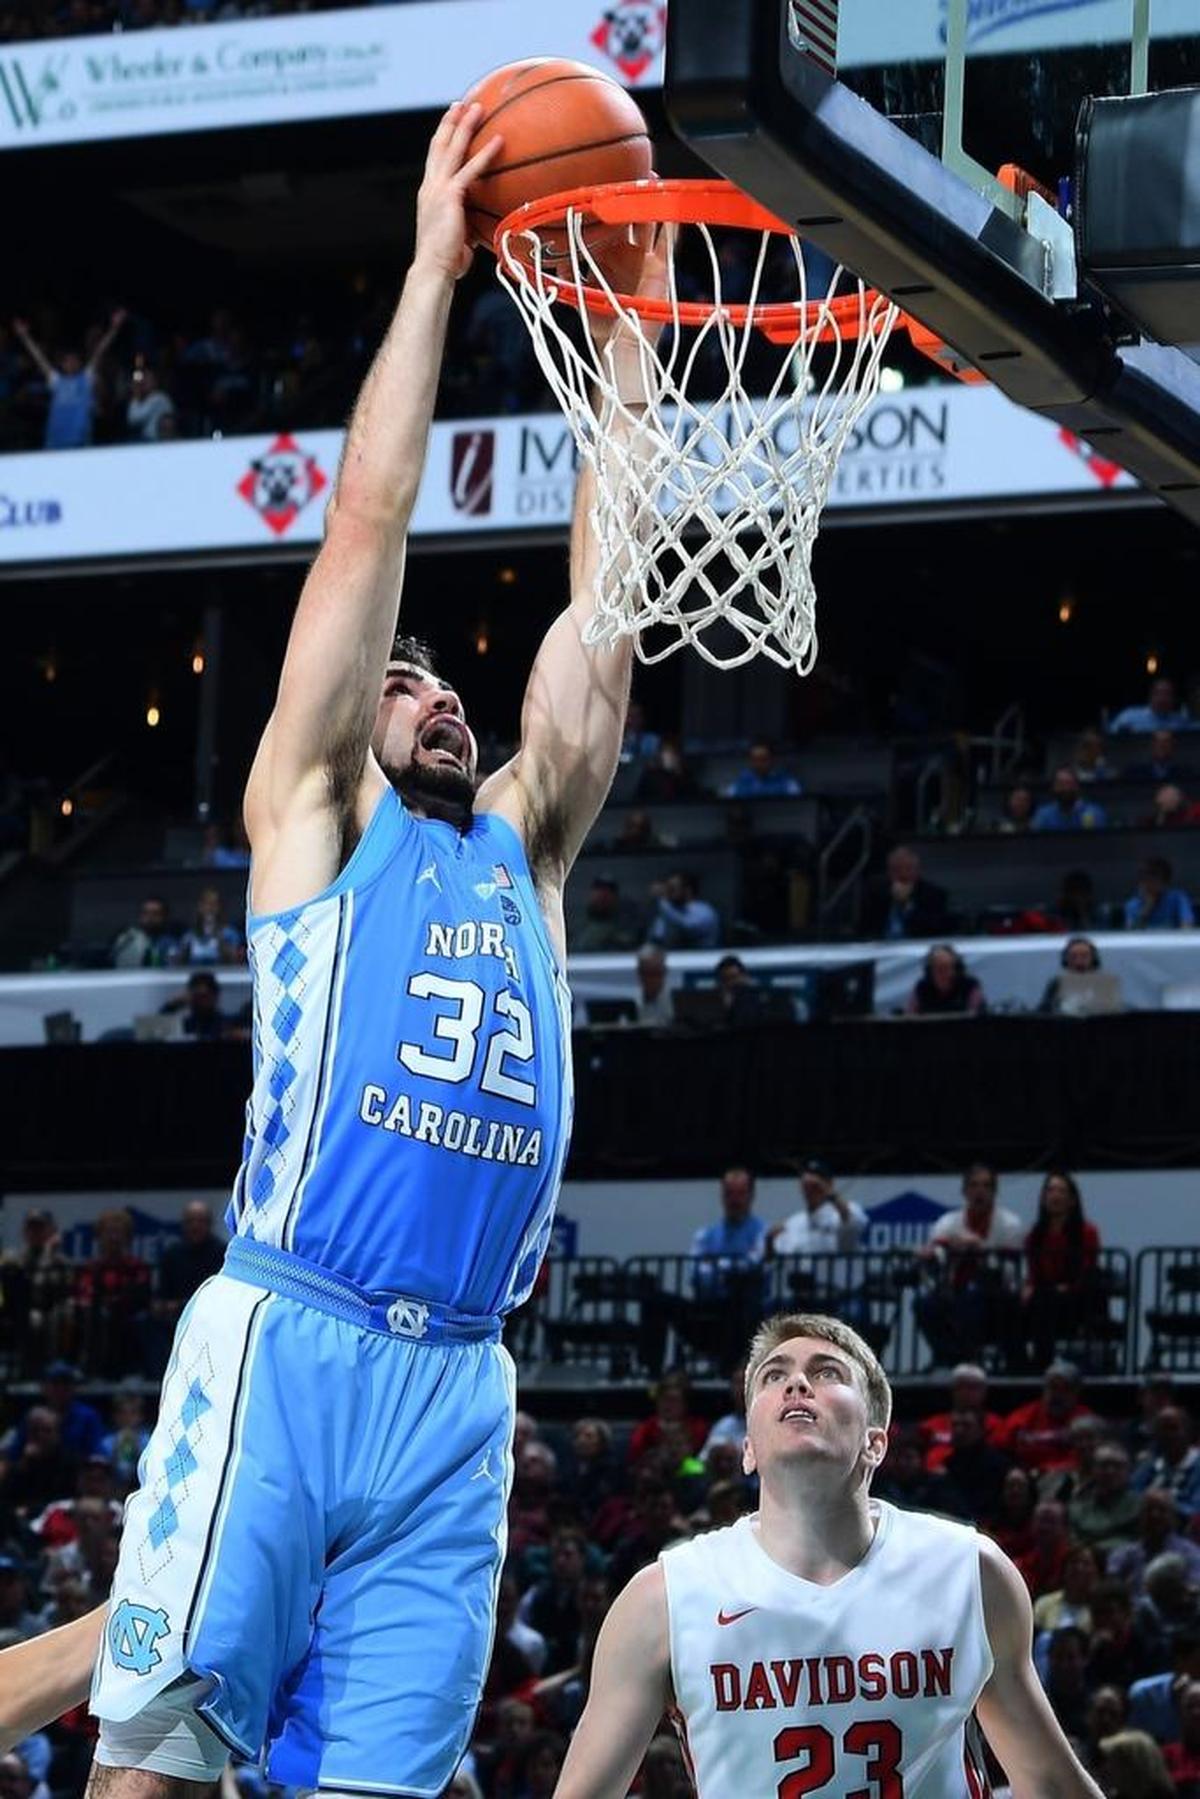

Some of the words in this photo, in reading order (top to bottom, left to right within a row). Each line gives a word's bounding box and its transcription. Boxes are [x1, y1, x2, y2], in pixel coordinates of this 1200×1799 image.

[397, 971, 537, 1107] 32
[359, 1083, 543, 1167] CAROLINA
[709, 1647, 955, 1711] DAVIDSON
[773, 1719, 904, 1799] 23
